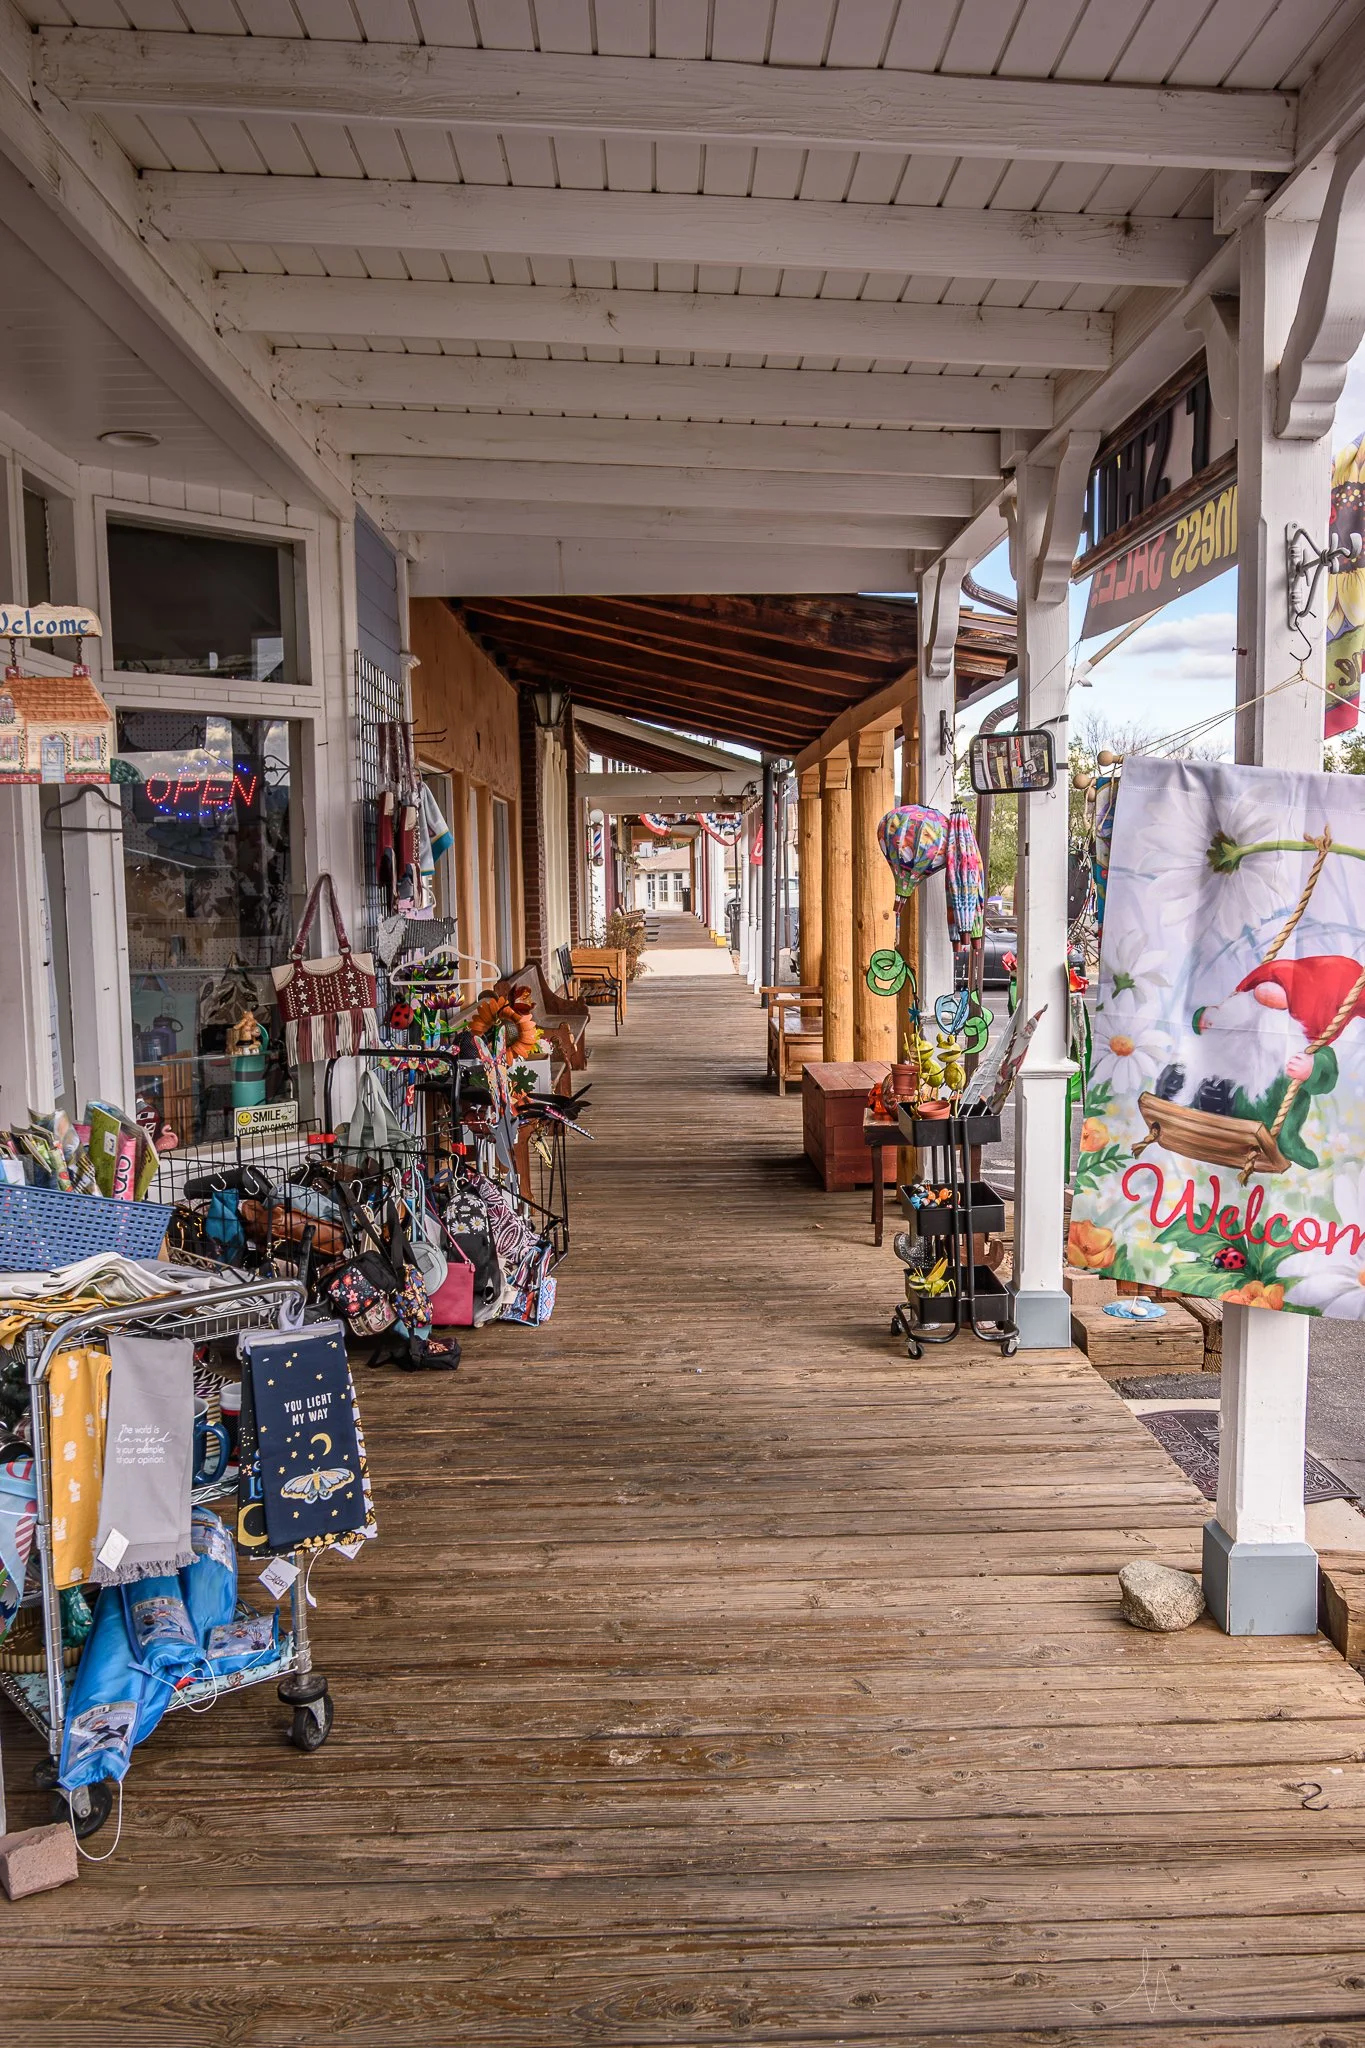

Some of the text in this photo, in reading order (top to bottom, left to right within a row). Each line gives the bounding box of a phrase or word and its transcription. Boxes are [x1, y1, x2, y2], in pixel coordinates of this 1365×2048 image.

[146, 772, 257, 807] OPEN
[252, 1110, 281, 1123] SMILE
[284, 1392, 332, 1413] YOU LIGHT
[292, 1408, 328, 1426] MY WAY
[121, 1424, 160, 1434] The world is
[121, 1447, 135, 1457] your
[137, 1455, 165, 1466] opinion.
